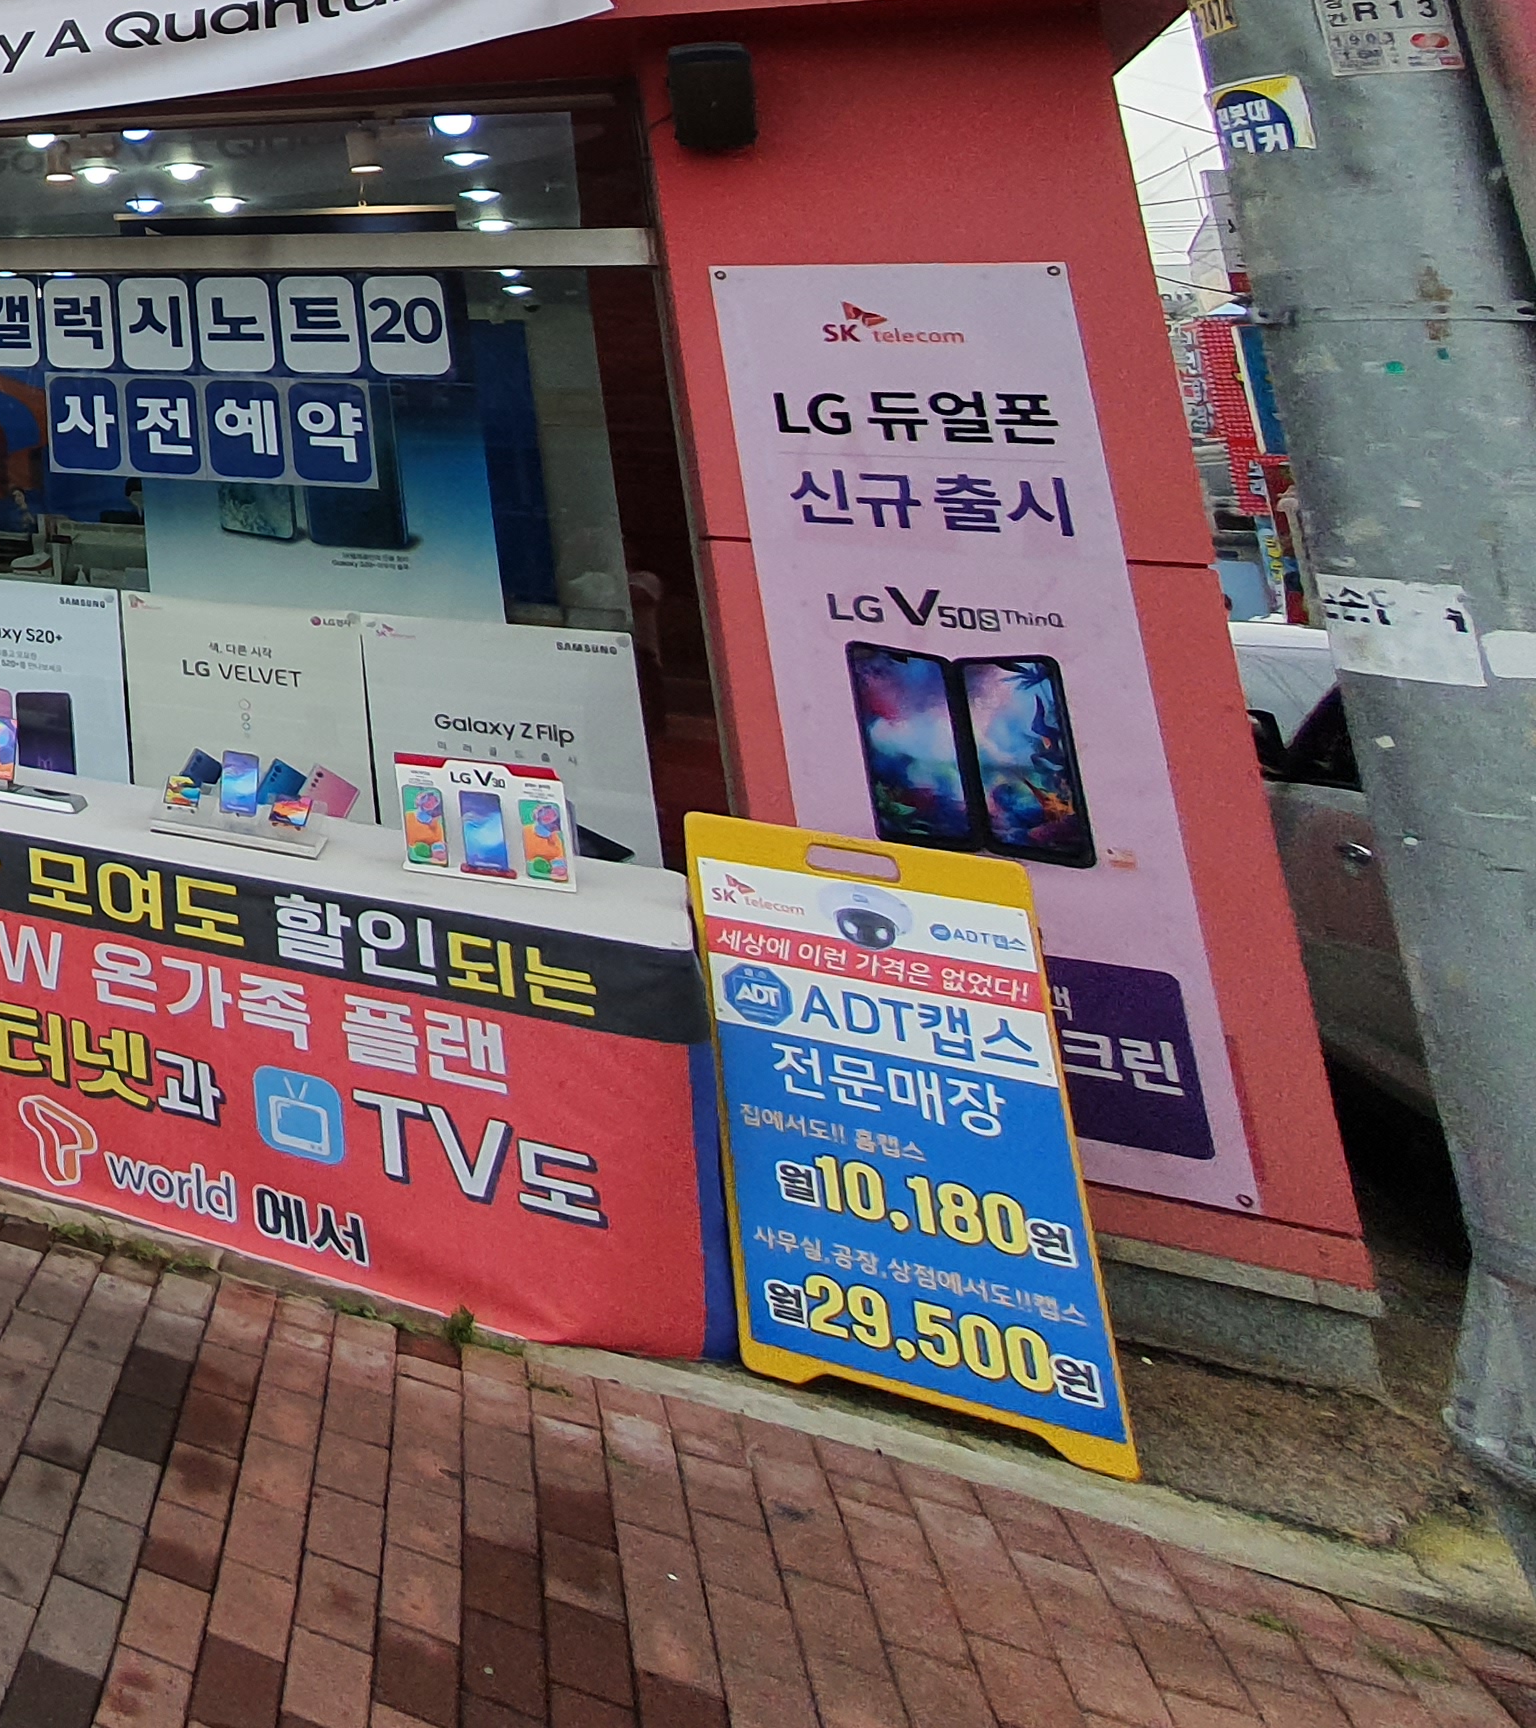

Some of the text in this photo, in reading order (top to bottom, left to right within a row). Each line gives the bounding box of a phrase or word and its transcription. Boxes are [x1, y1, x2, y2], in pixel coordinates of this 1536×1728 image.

[1354, 0, 1438, 22] R13
[44, 18, 92, 58] A
[823, 323, 965, 345] SK telecom
[57, 394, 364, 463] 사전예약
[773, 390, 1059, 445] LG 듀얼폰
[790, 468, 1075, 537] 신규 출시
[59, 596, 105, 609] SAMSUNG
[827, 592, 884, 623] LG
[1002, 608, 1065, 629] ThinQ
[25, 627, 63, 645] S20+
[556, 641, 618, 656] SAMSUNG
[182, 659, 302, 688] LG VELVET
[434, 712, 575, 748] Galaxy Z Flip
[450, 770, 472, 785] LG
[711, 886, 805, 917] SK telecom
[27, 847, 245, 947] 모여도
[273, 892, 597, 1017] 할인되는
[716, 927, 1029, 1003] 세상에 이런 가격은 없었다!
[92, 940, 312, 1052] 온가족
[341, 991, 510, 1097] 플랜
[736, 980, 1040, 1069] ADT ADT캡스
[771, 1041, 1006, 1138] 전문매장
[740, 1103, 846, 1145] 집에서도!!
[352, 1088, 608, 1229] TV도
[105, 1149, 370, 1267] world 에서
